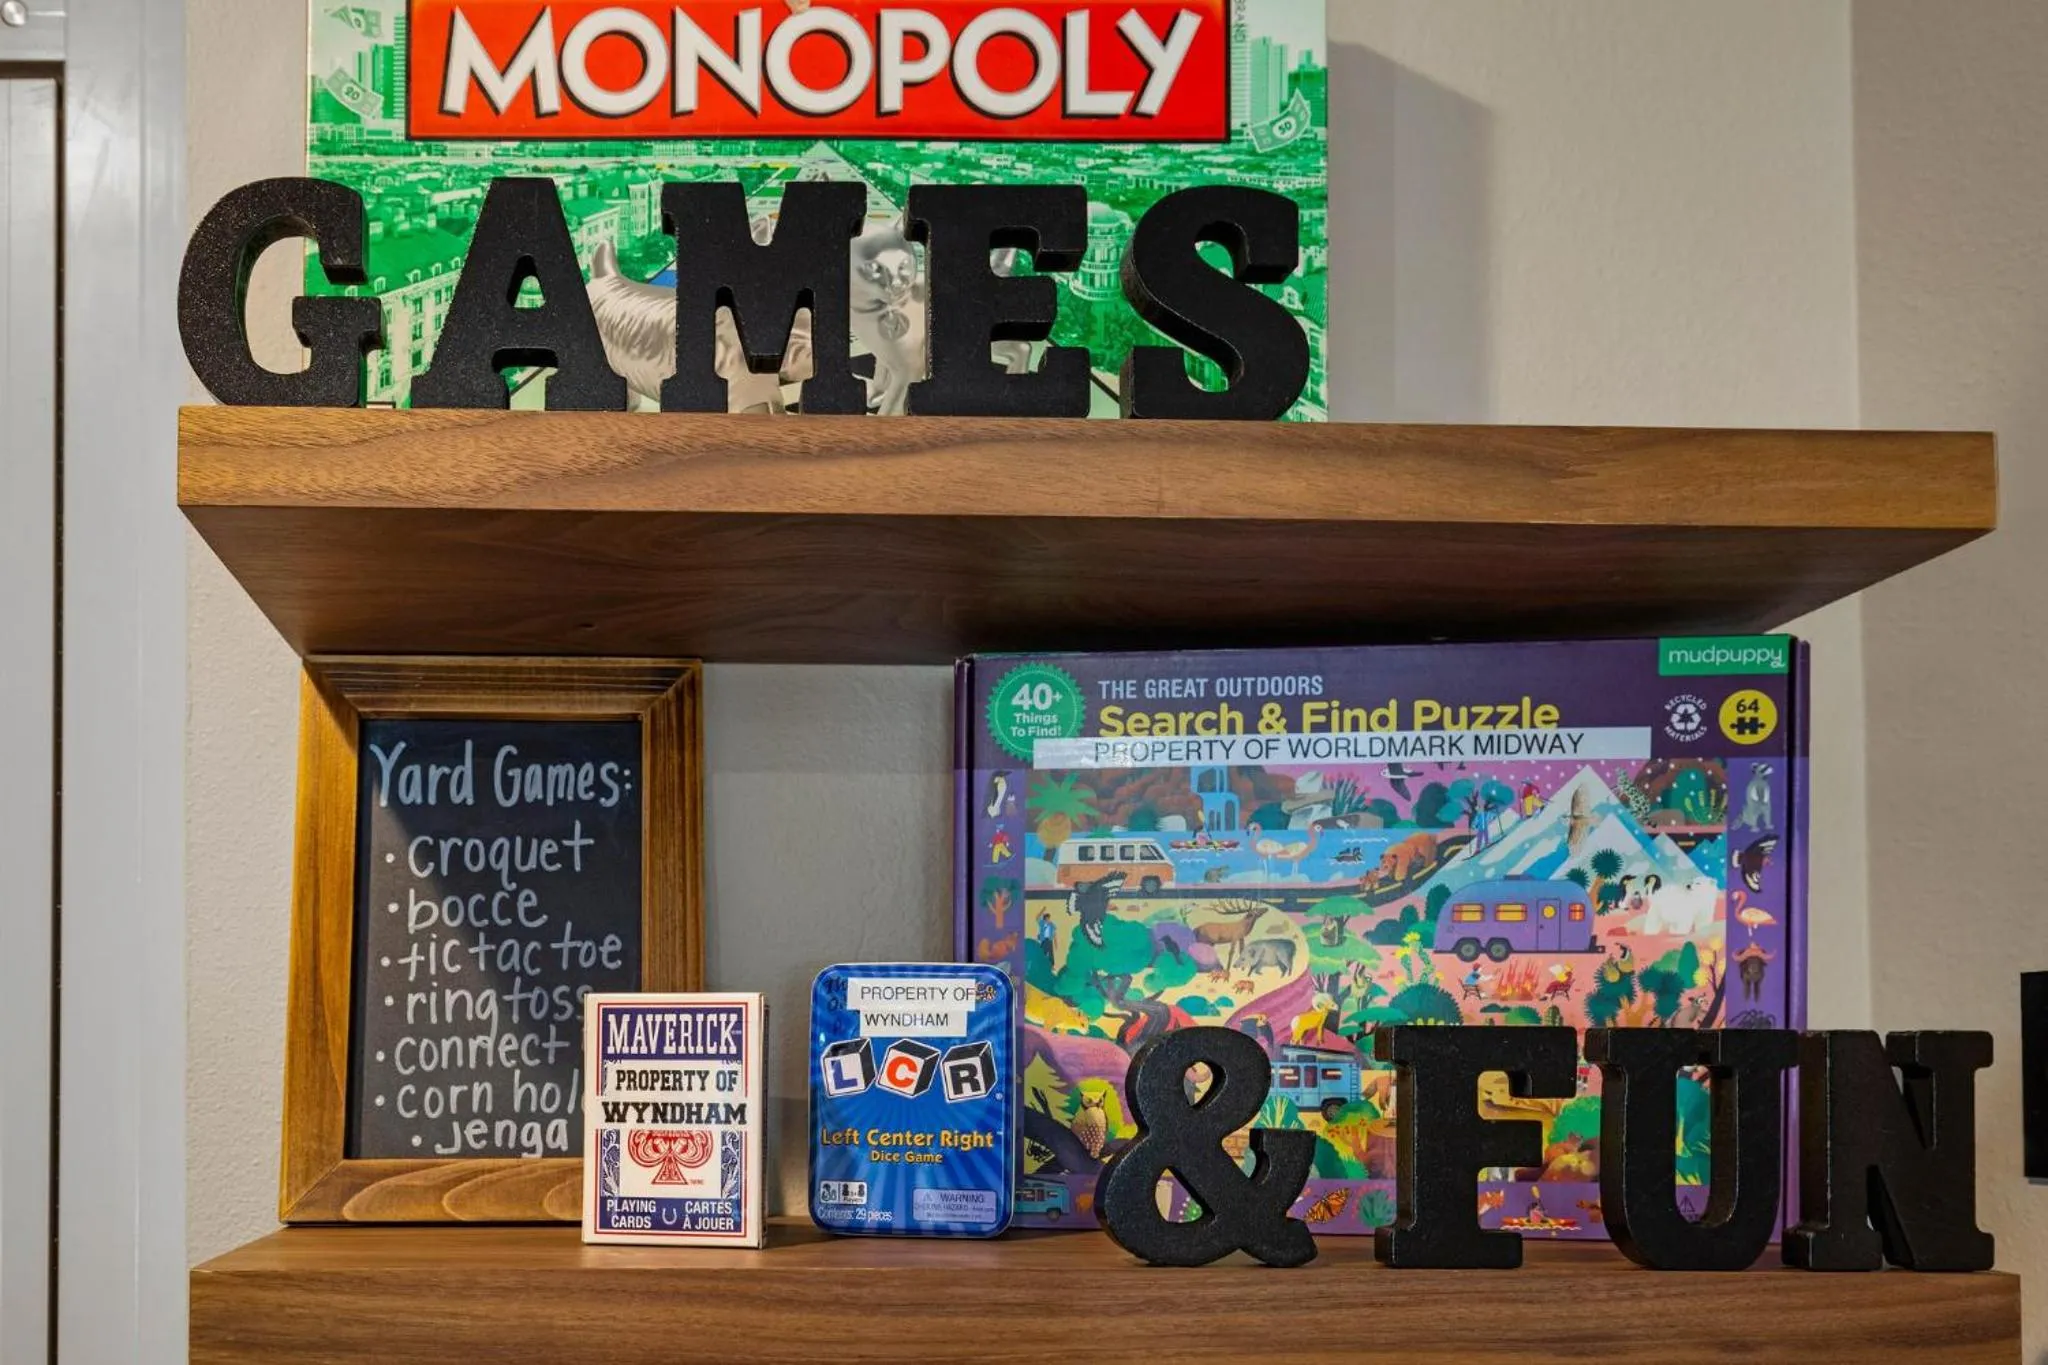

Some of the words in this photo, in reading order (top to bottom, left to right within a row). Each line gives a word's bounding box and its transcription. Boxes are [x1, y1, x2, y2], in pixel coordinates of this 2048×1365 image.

[440, 5, 1203, 118] MONOPOLY
[178, 177, 1310, 418] GAMES
[1667, 646, 1785, 668] mudpuppy
[1011, 682, 1063, 711] 40+
[1098, 680, 1137, 700] THE
[1144, 678, 1208, 699] GREAT
[1216, 675, 1323, 697] OUTDOORS
[1664, 694, 1707, 711] RECYCLED
[1736, 698, 1760, 714] 64
[1013, 712, 1059, 726] Things
[1100, 701, 1244, 737] Search
[1257, 702, 1287, 736] &
[1302, 699, 1398, 734] Find
[1413, 696, 1560, 731] Puzzle
[1010, 726, 1026, 737] To
[1027, 725, 1062, 737] Find!
[1664, 725, 1707, 742] MATERIALS
[1094, 738, 1236, 763] PROPERTY
[1244, 738, 1280, 761] OF
[1289, 734, 1464, 760] WORLDMARK
[1474, 732, 1585, 756] MIDWAY
[369, 739, 475, 807] Yard
[493, 744, 632, 808] Games:
[408, 820, 595, 891] croquet
[407, 888, 548, 934] bocce
[860, 986, 948, 1000] PROPERTY
[953, 986, 976, 1001] OF
[864, 1013, 949, 1027] WYNDHAM
[607, 1013, 739, 1056] MAVERICK
[394, 1025, 571, 1076] connect
[615, 1069, 711, 1092] PROPERTY
[716, 1070, 738, 1092] OF
[397, 1080, 493, 1119] corn
[513, 1068, 585, 1115] hol
[602, 1102, 748, 1126] WYNDHAM
[821, 1128, 859, 1147] Left
[867, 1130, 935, 1147] Center
[940, 1130, 995, 1151] Right
[1094, 1025, 1319, 1269] &
[1373, 1025, 1996, 1272] FUN
[870, 1151, 900, 1163] Dice
[905, 1152, 943, 1164] Game
[606, 1200, 657, 1214] PLAYING
[684, 1201, 733, 1214] CARTES
[940, 1192, 985, 1204] WARNING
[611, 1216, 652, 1229] CARDS
[683, 1214, 692, 1230] À
[695, 1217, 734, 1230] JOUER
[867, 1208, 893, 1222] pieces
